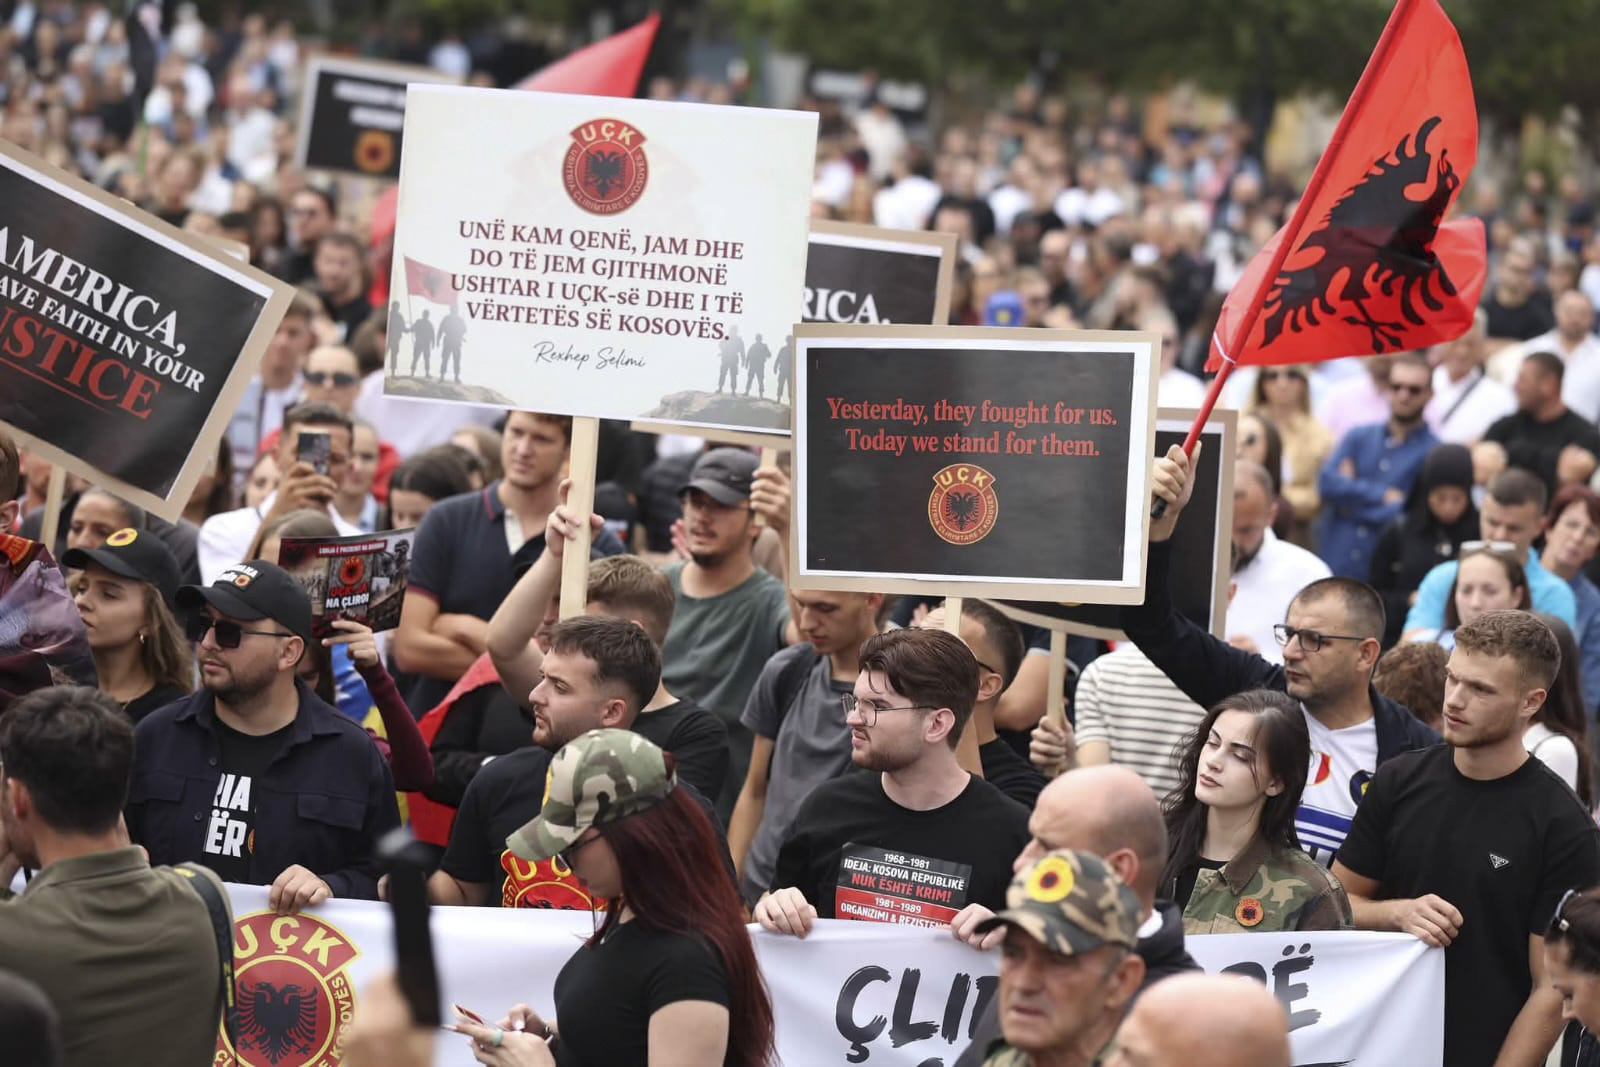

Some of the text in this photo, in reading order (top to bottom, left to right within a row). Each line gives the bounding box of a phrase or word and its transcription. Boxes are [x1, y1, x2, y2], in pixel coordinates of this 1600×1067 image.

[580, 121, 636, 145] UÇK
[459, 218, 744, 260] UNË KAM QENË, JAM DHE
[469, 247, 727, 286] DO TË JEM GJITHMONË
[450, 273, 744, 315] USHTAR I UÇK-së DHE I TË
[466, 298, 730, 341] VËRTETËS SË KOSOVËS.
[38, 295, 111, 345] FAITH
[109, 331, 141, 360] IN
[142, 345, 206, 393] YOUR
[533, 340, 646, 371] Rexhep Selimi
[826, 397, 1118, 429] Yesterday, they fought for us.
[844, 428, 1101, 457] Today we stand for them.
[940, 467, 989, 488] UÇK
[325, 597, 340, 609] NA
[843, 857, 872, 873] IDEJA:
[872, 863, 909, 880] KOSOVA
[851, 873, 876, 888] NUK
[915, 885, 953, 904] KRIM!
[840, 902, 889, 921] ORGANIZIMI
[891, 914, 898, 923] &
[234, 916, 344, 967] UÇK
